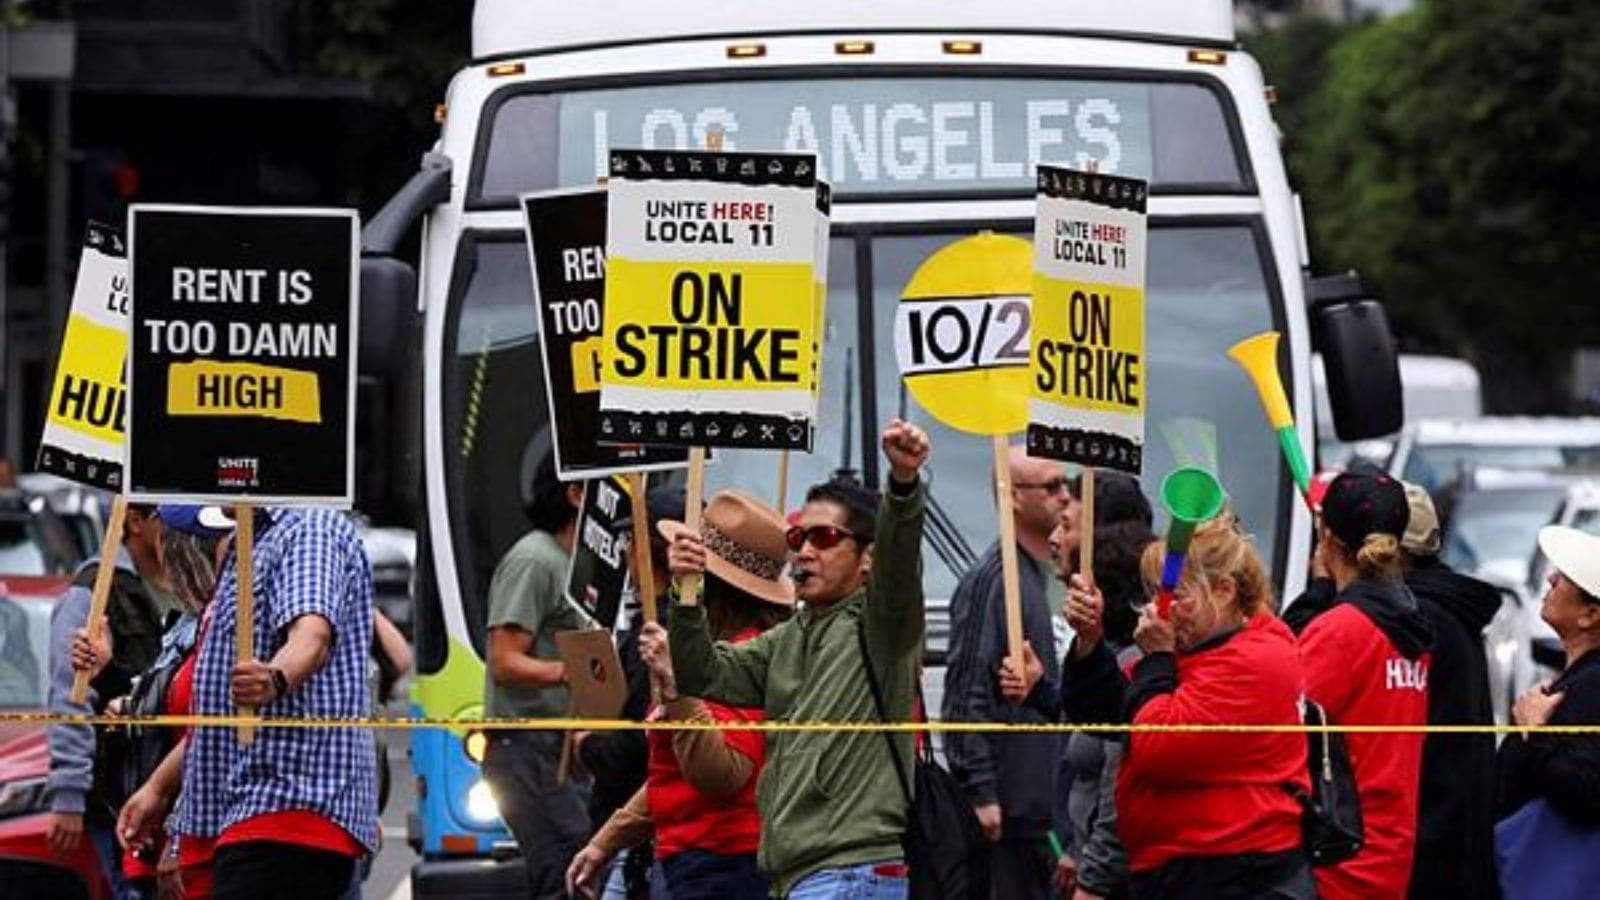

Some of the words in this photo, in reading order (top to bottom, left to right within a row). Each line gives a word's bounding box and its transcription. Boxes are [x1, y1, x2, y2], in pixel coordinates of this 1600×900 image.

[783, 98, 1122, 181] ANGELES
[646, 200, 707, 219] UNITE
[711, 202, 774, 222] HERE!
[645, 221, 734, 244] LOCAL
[748, 224, 774, 246] 11
[1055, 218, 1089, 240] UNITE
[1090, 223, 1126, 244] HERE!
[1054, 238, 1107, 266] LOCAL
[1112, 246, 1127, 269] 11
[172, 266, 266, 304] RENT
[279, 270, 313, 305] IS
[671, 271, 742, 327] ON
[548, 298, 600, 335] TOO
[1068, 290, 1111, 347] ON
[144, 319, 216, 355] TOO
[228, 322, 338, 357] DAMN
[613, 323, 800, 383] STRIKE
[197, 373, 283, 409] HIGH
[1036, 338, 1140, 407] STRIKE
